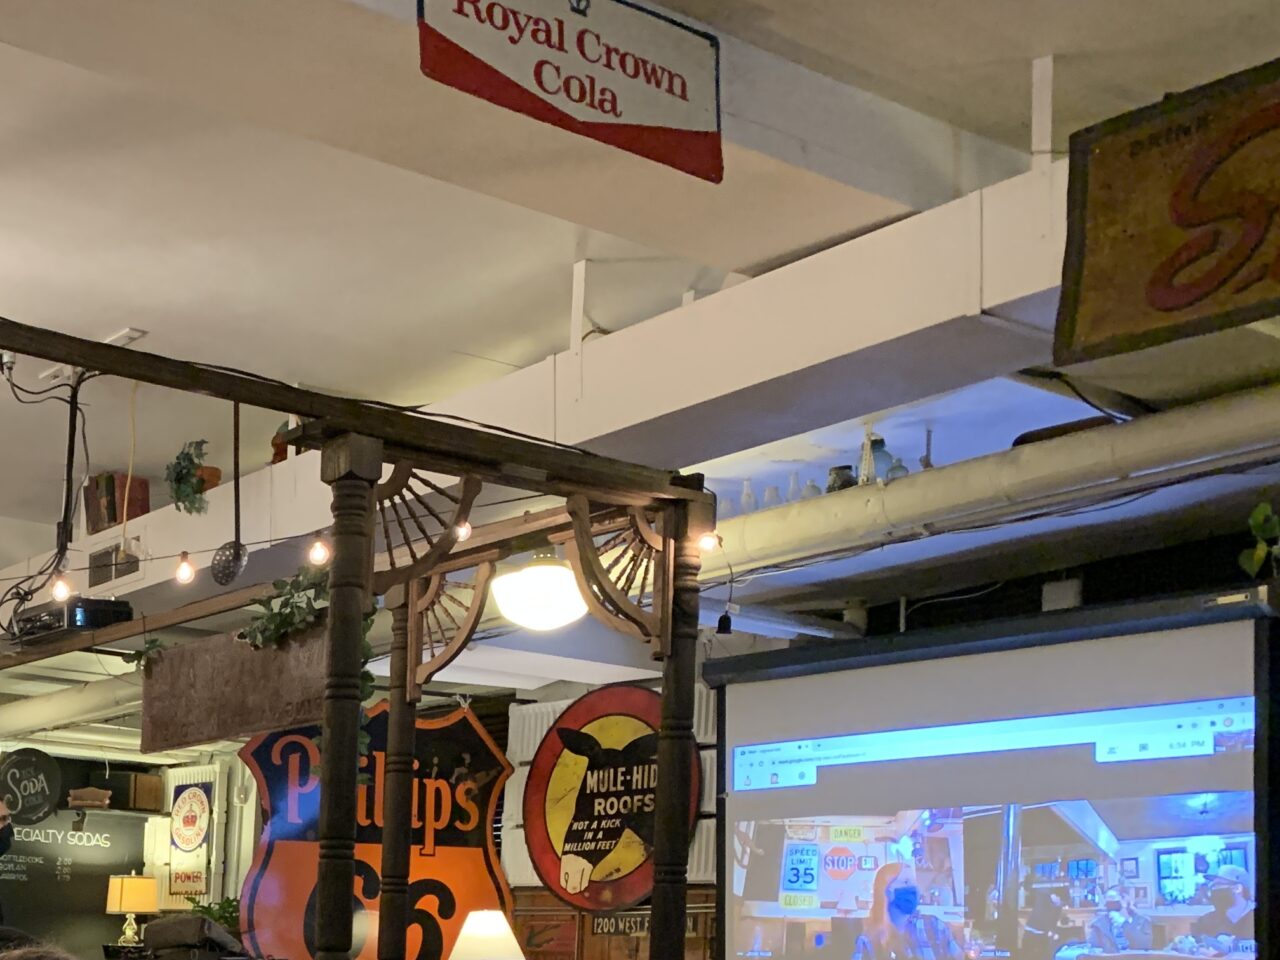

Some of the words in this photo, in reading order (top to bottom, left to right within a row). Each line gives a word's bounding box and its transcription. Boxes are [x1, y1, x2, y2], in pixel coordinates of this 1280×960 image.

[576, 28, 689, 102] Crown
[533, 59, 623, 118] Cola
[586, 764, 658, 794] MULE-HID
[4, 768, 50, 814] SODA
[271, 735, 480, 856] Pilips
[188, 791, 207, 815] CROWN
[594, 794, 655, 816] ROOFS
[591, 821, 598, 830] A
[602, 818, 621, 829] KICK
[14, 827, 64, 844] ECIALTY
[67, 831, 111, 848] SODAS
[174, 827, 205, 846] GASOLINE
[584, 831, 593, 840] IN
[597, 830, 603, 839] A
[834, 828, 861, 839] DANGER
[564, 841, 595, 852] MILLION
[789, 848, 818, 857] SPEED
[791, 857, 813, 866] LIMIT
[825, 855, 854, 871] STOP
[174, 871, 203, 883] POWER
[787, 867, 815, 885] 35
[784, 894, 814, 907] CLOSED
[594, 918, 616, 933] 1200
[618, 917, 642, 933] WEST
